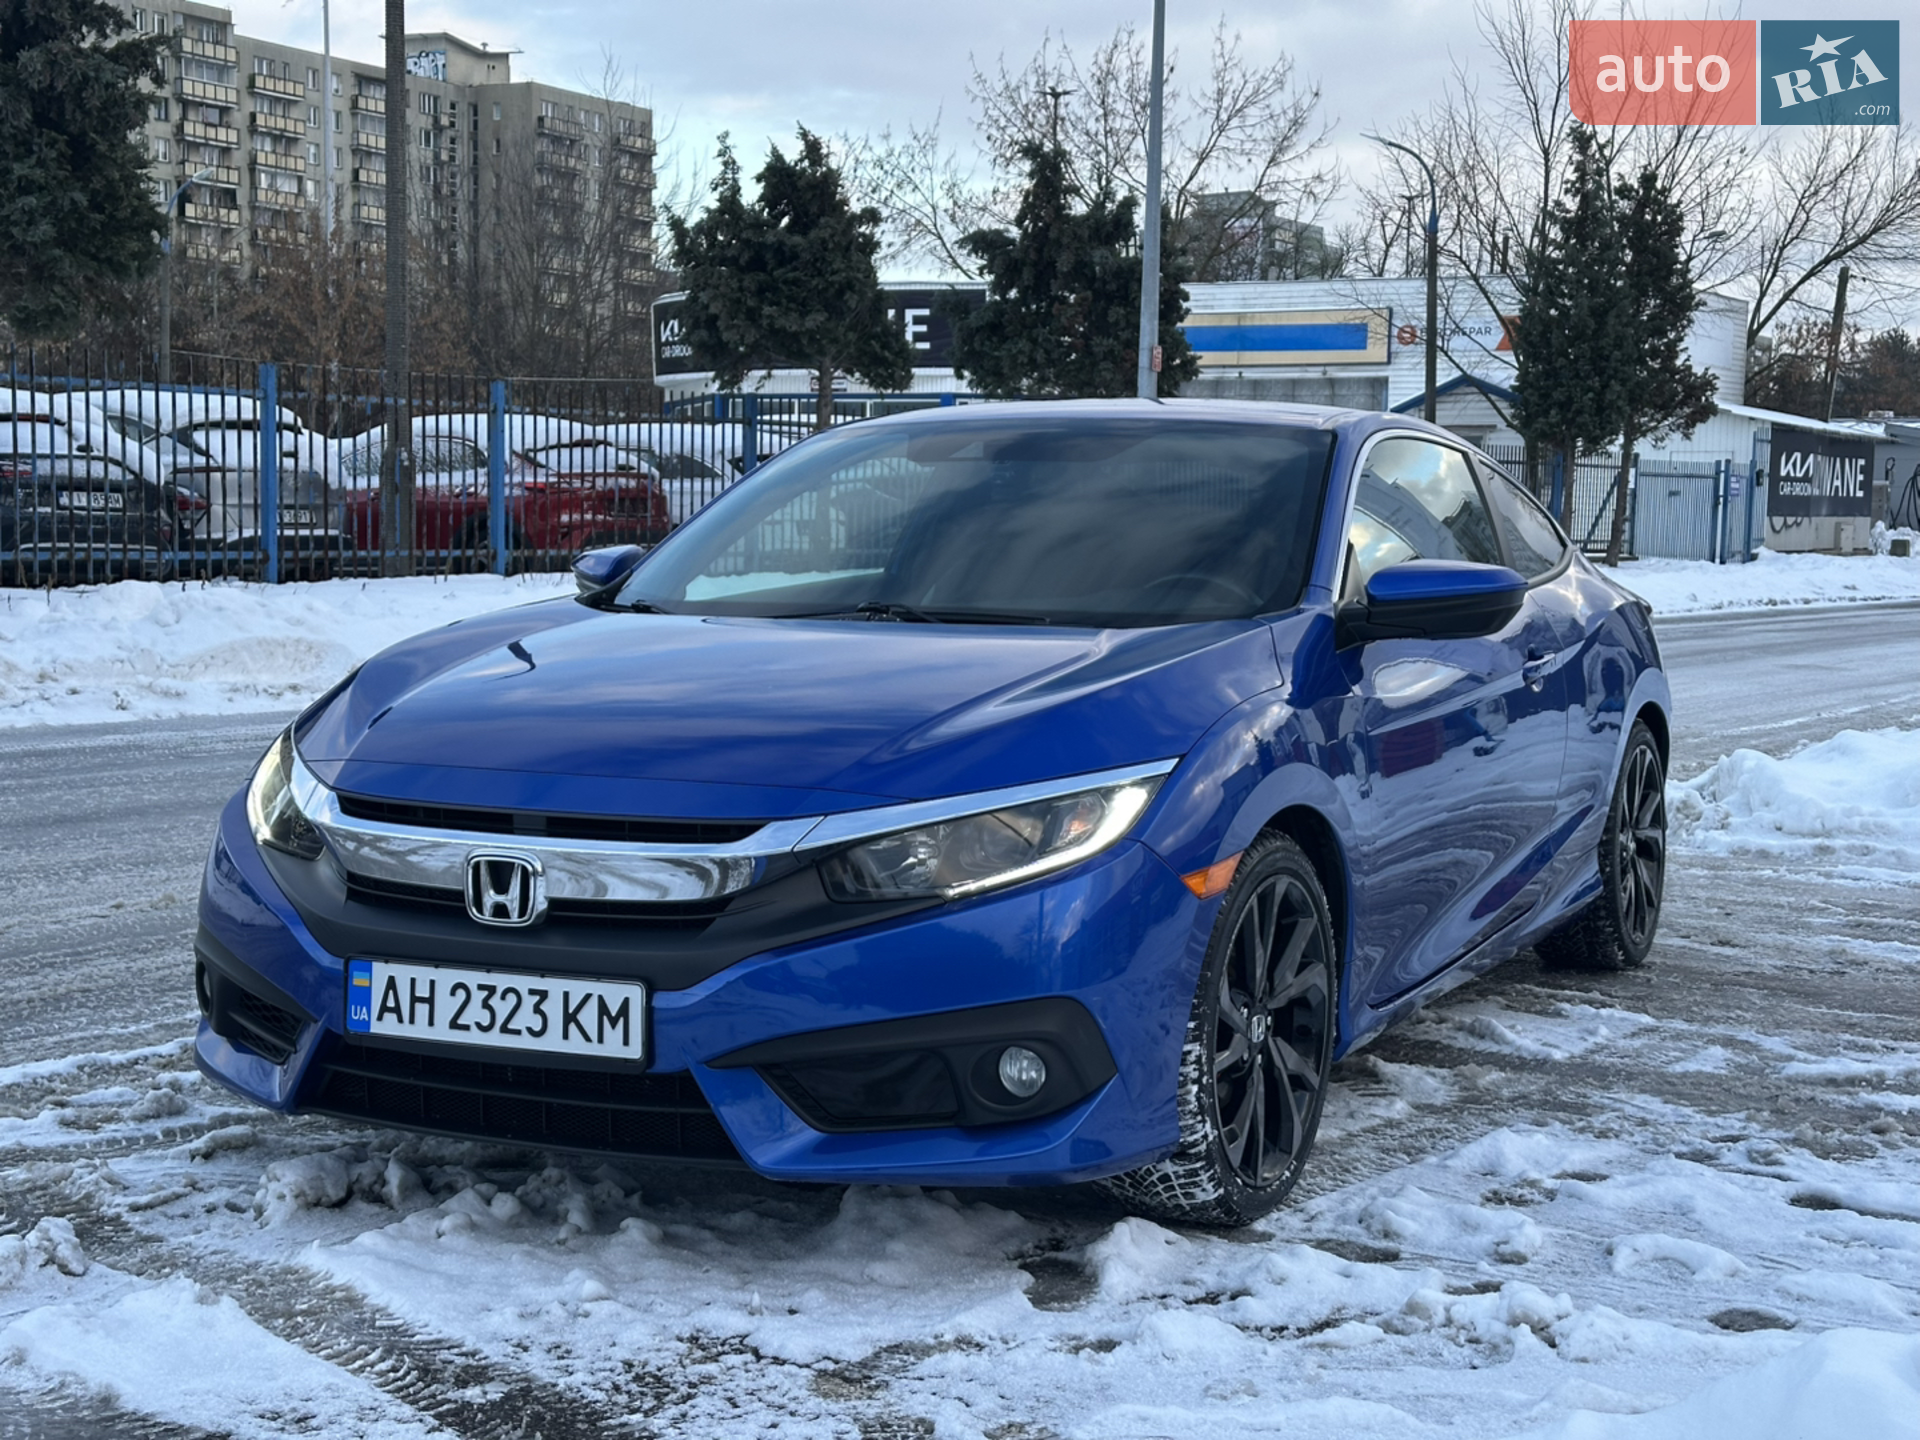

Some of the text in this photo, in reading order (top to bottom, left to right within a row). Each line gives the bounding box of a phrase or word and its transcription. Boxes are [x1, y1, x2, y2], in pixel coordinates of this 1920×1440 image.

[1420, 326, 1493, 338] EROREPAR
[351, 1004, 369, 1021] UA
[376, 975, 631, 1048] AH 2323 KM
